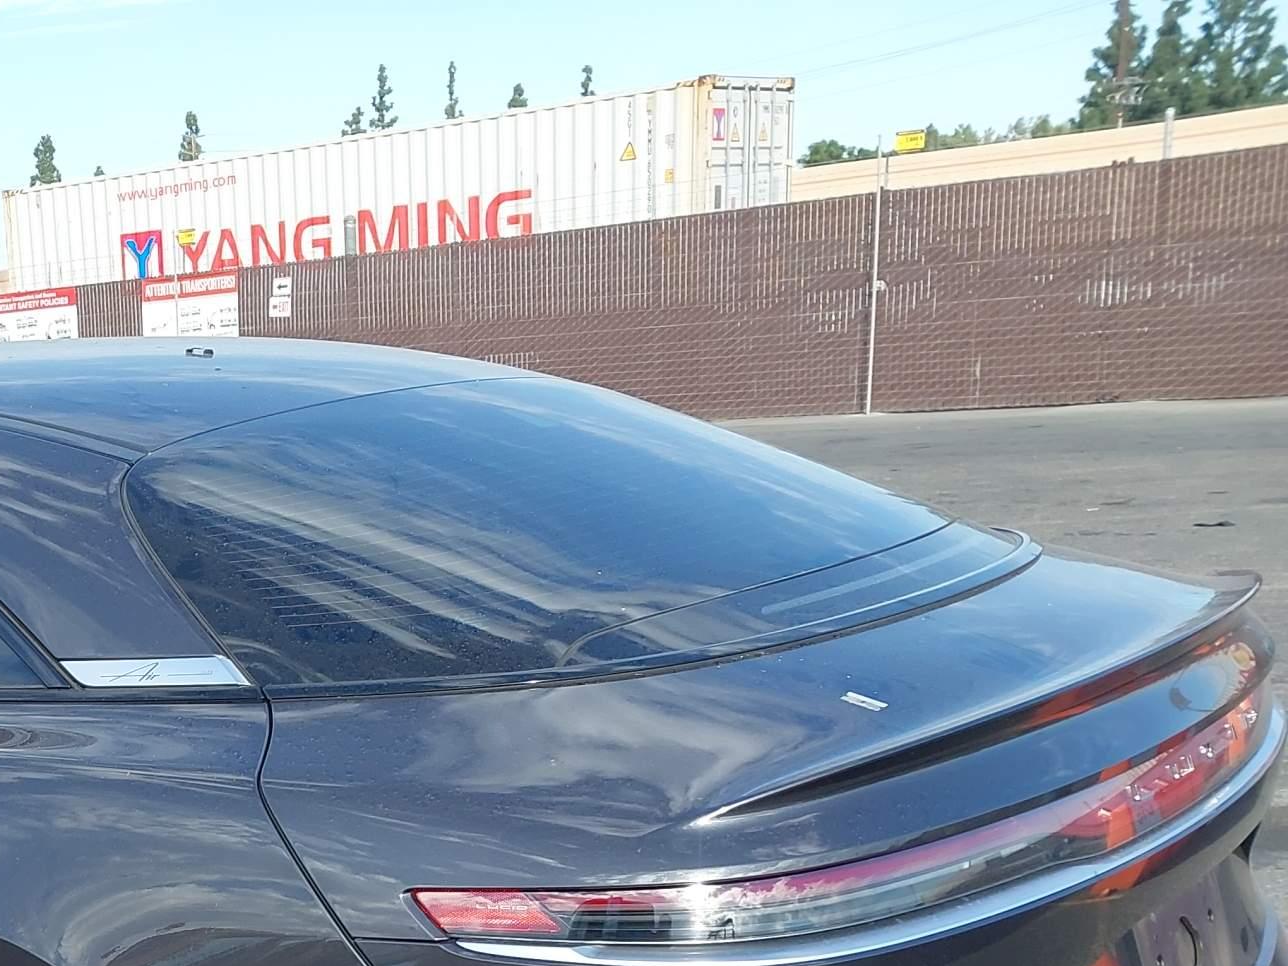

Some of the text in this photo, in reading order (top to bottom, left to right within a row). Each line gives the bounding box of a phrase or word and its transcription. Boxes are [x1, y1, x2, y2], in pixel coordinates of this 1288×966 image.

[116, 174, 237, 202] www.yangming.com
[183, 189, 532, 273] YANG MING
[17, 300, 40, 310] SAFETY
[40, 296, 69, 307] POLICIES
[100, 662, 161, 682] Air
